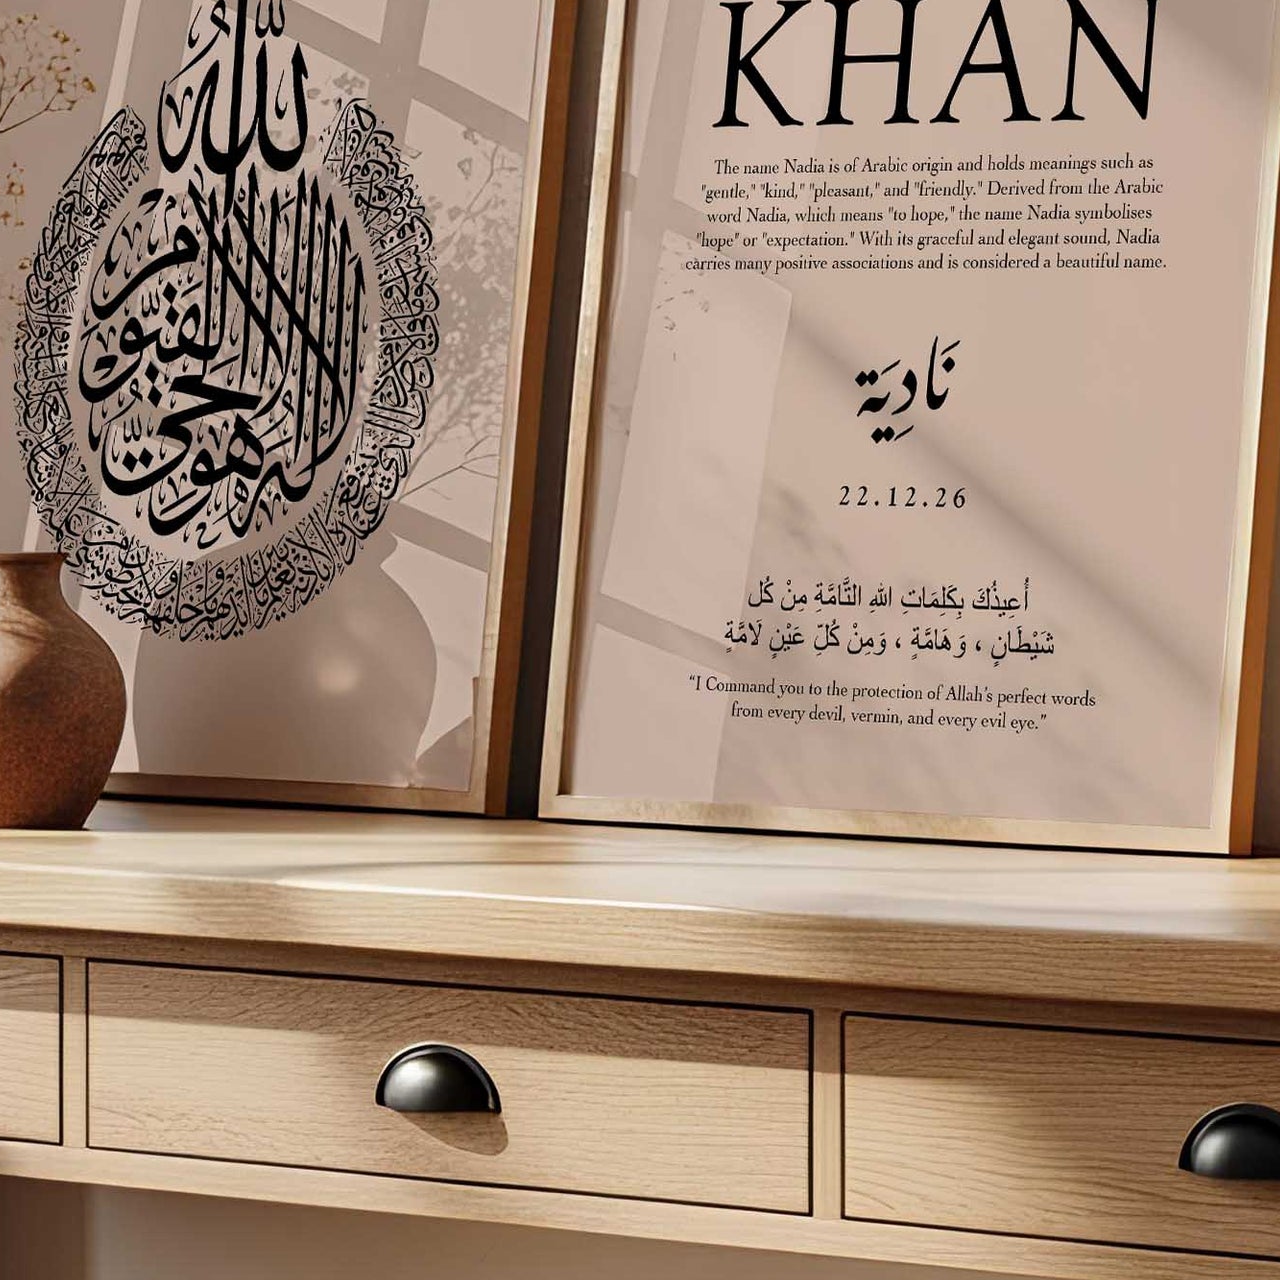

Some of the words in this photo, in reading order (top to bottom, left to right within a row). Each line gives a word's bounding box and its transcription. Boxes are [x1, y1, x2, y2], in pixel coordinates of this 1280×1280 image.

[714, 159, 739, 174] The
[744, 164, 779, 174] name
[784, 157, 825, 174] Nadia
[829, 158, 840, 173] is
[844, 157, 860, 173] of
[861, 156, 908, 172] Arabic
[912, 157, 952, 176] origin
[957, 155, 983, 171] and
[988, 154, 1025, 170] holds
[1029, 154, 1096, 174] meanings
[1101, 152, 1133, 169] such
[1139, 159, 1153, 168] as
[702, 182, 755, 204] "gentle,"
[761, 182, 805, 199] "kind,"
[810, 181, 880, 202] "pleasant,"
[884, 180, 909, 196] and
[915, 180, 982, 201] "friendly."
[987, 179, 1045, 195] Derived
[1049, 179, 1082, 195] from
[1088, 178, 1109, 194] the
[1114, 177, 1163, 194] Arabic
[707, 206, 741, 223] word
[746, 206, 790, 224] Nadia,
[795, 205, 835, 222] which
[840, 212, 883, 221] means
[889, 206, 906, 221] "to
[911, 204, 955, 226] hope,"
[959, 204, 980, 220] the
[985, 211, 1022, 220] name
[1027, 203, 1071, 220] Nadia
[1075, 203, 1152, 225] symbolises
[697, 231, 739, 252] "hope"
[743, 237, 758, 247] or
[763, 231, 855, 251] "expectation."
[859, 230, 892, 246] With
[897, 231, 913, 246] its
[917, 229, 974, 251] graceful
[978, 229, 1004, 245] and
[1008, 229, 1059, 250] elegant
[1064, 228, 1110, 246] sound,
[1116, 228, 1160, 244] Nadia
[686, 256, 730, 275] carries
[735, 260, 772, 275] many
[774, 254, 827, 275] positive
[832, 254, 914, 269] associations
[918, 253, 943, 269] and
[948, 254, 959, 269] is
[963, 252, 1039, 269] considered
[1043, 259, 1051, 268] a
[1057, 252, 1119, 268] beautiful
[1124, 258, 1166, 268] name.
[839, 486, 965, 508] 22.12.26
[706, 676, 775, 694] Command
[777, 685, 804, 699] you
[809, 683, 822, 695] to
[827, 680, 848, 697] the
[852, 684, 922, 702] protection
[927, 684, 944, 700] of
[997, 687, 1047, 708] perfect
[1051, 689, 1096, 706] words
[732, 700, 763, 718] from
[768, 709, 805, 725] every
[809, 704, 845, 722] devil,
[851, 709, 902, 725] vermin,
[908, 709, 933, 725] and
[938, 716, 977, 731] every
[981, 712, 1006, 728] evil
